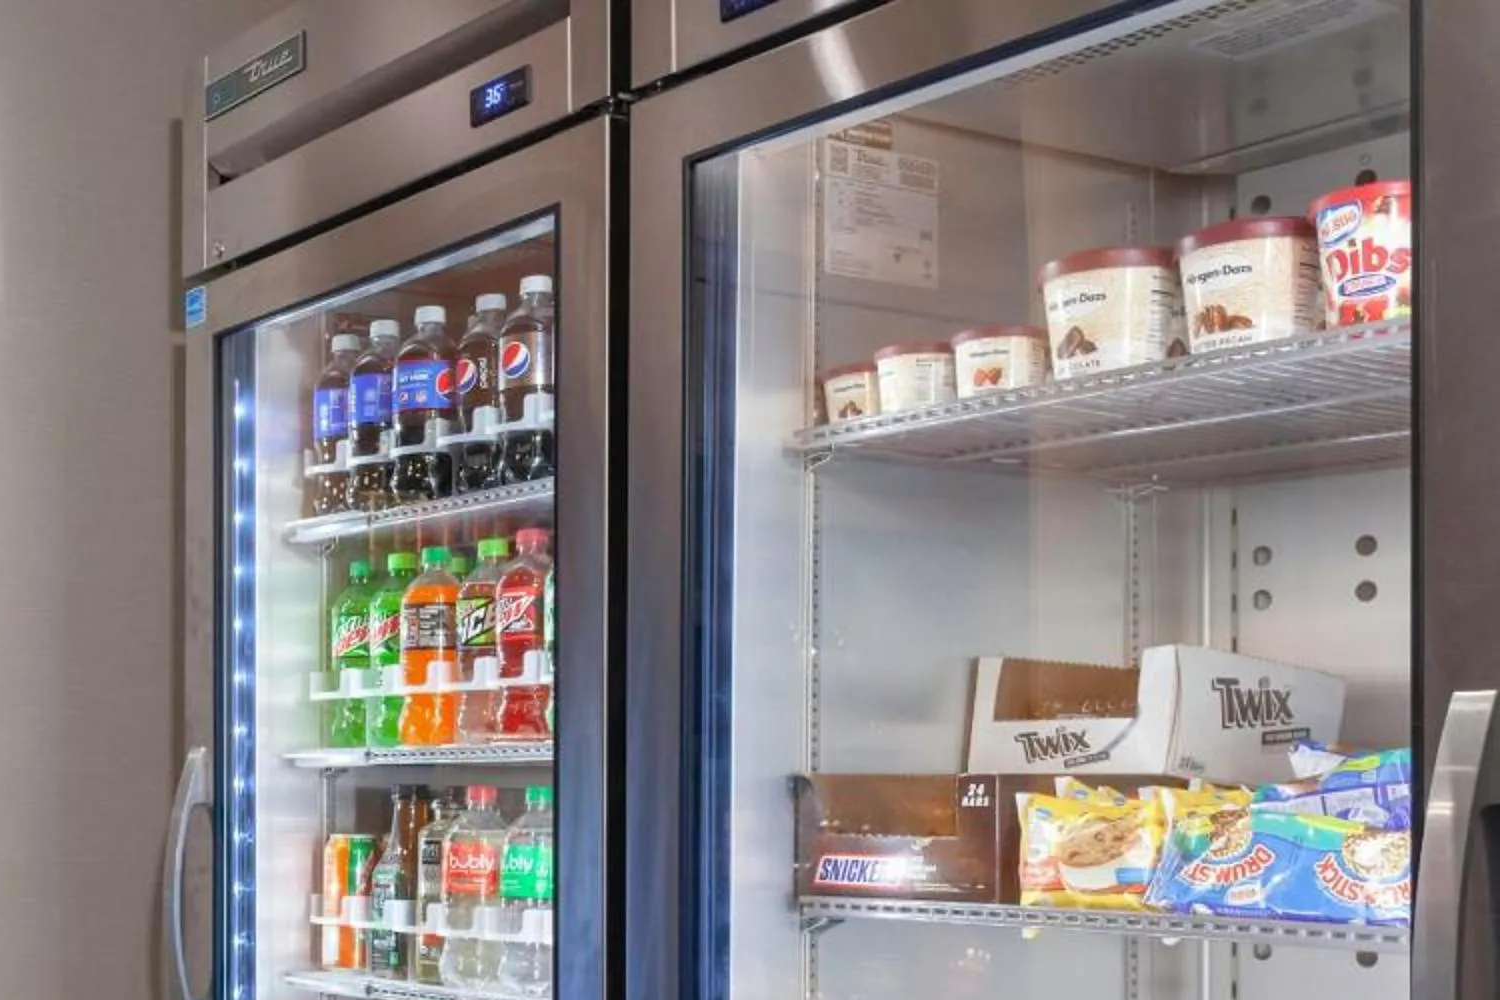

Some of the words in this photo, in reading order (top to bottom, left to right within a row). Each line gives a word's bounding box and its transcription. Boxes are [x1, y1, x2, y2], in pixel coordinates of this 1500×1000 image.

[1325, 237, 1412, 281] Dibs
[1212, 676, 1295, 728] Twix
[1014, 726, 1091, 763] Twix
[819, 857, 895, 882] SNICKE
